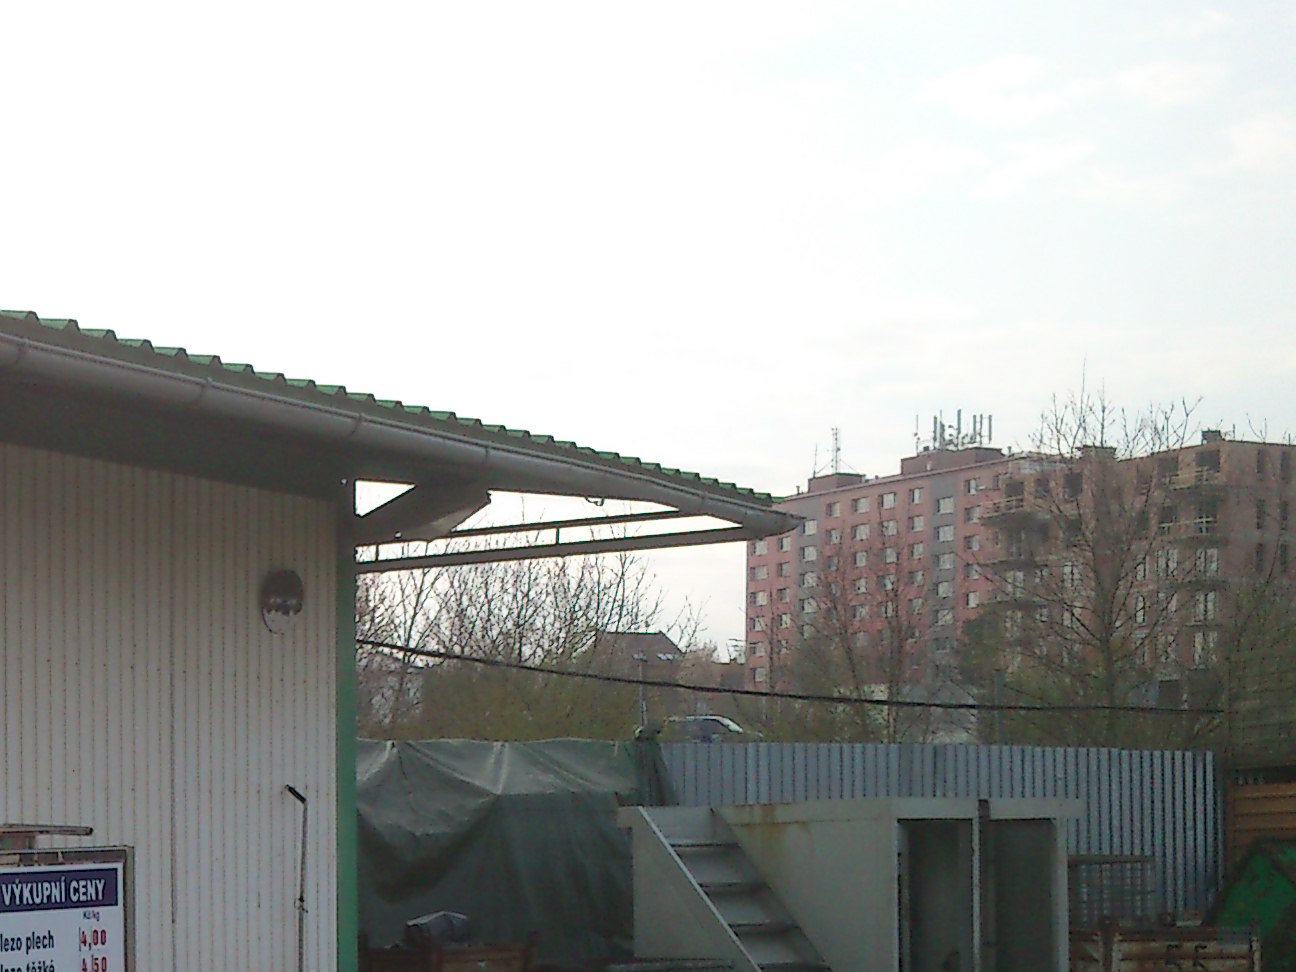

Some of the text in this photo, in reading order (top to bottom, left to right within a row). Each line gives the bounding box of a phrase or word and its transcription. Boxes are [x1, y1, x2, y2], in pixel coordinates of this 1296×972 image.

[1, 876, 105, 906] VÝKUPNÍ CENY
[26, 930, 55, 955] plech
[80, 929, 107, 950] 4,00
